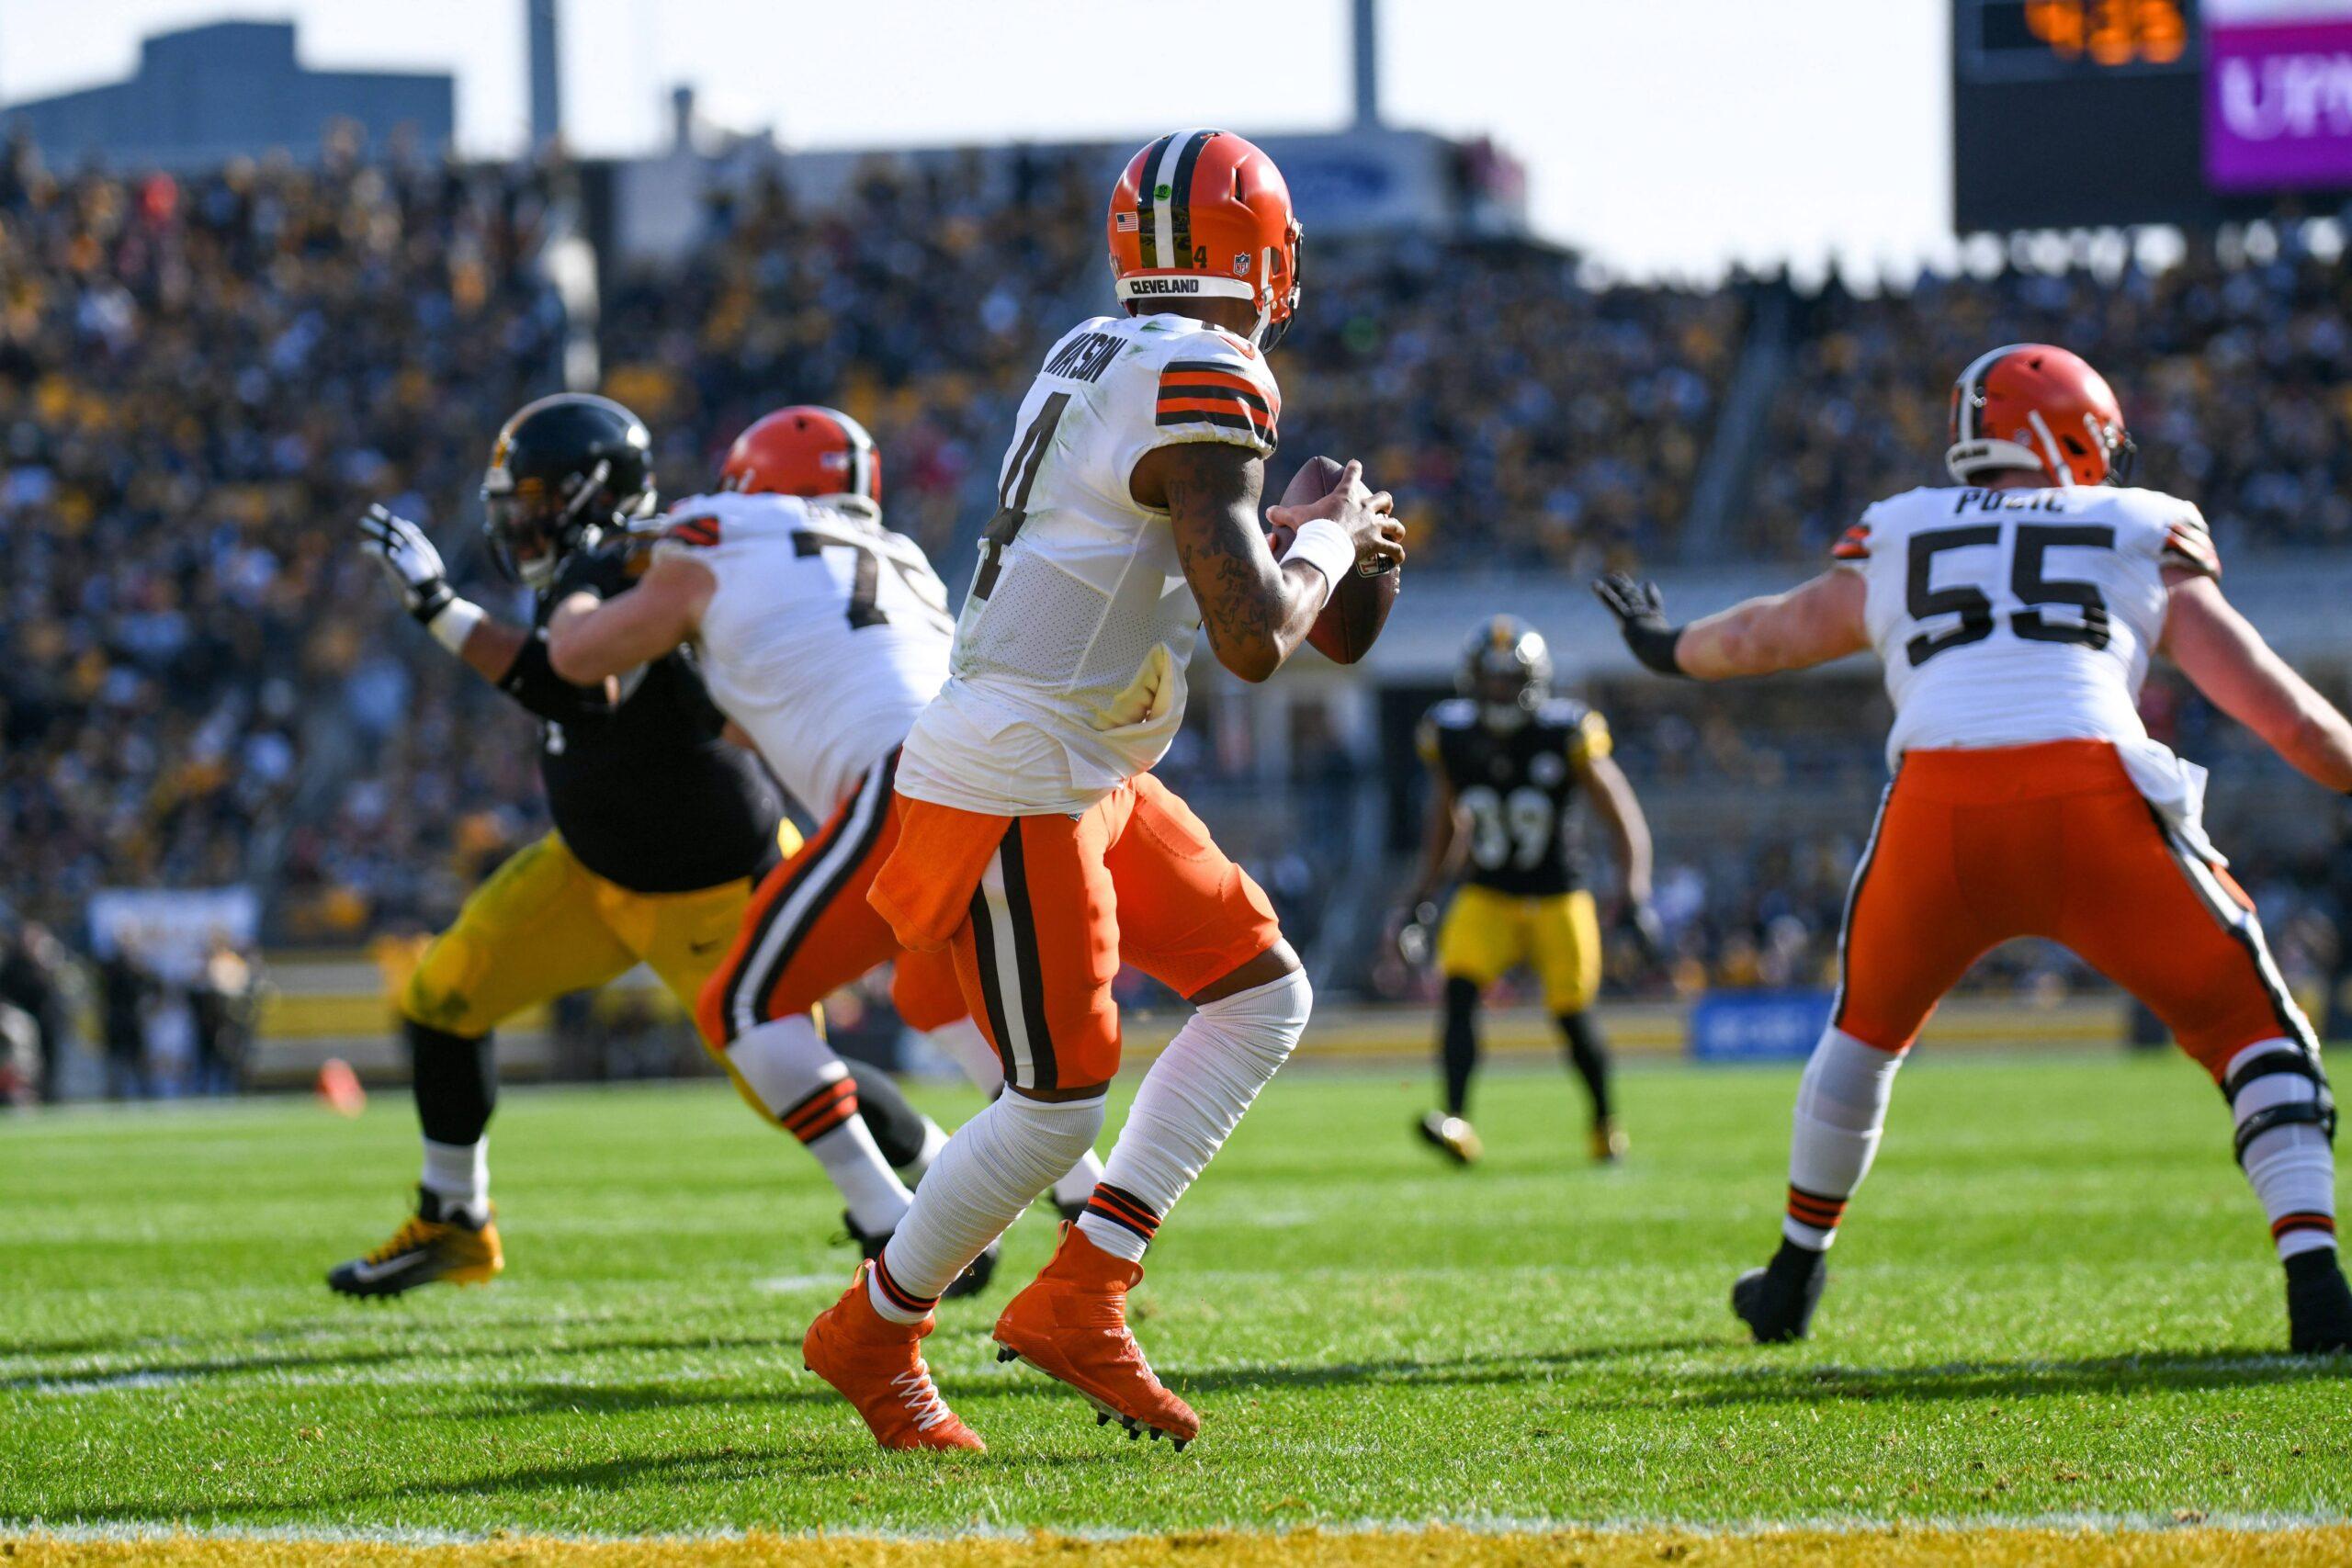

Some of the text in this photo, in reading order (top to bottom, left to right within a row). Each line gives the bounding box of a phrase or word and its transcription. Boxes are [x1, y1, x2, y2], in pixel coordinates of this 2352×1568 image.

[1130, 279, 1199, 295] CLEVELAND
[1193, 245, 1207, 269] 4
[972, 390, 1071, 602] 4
[1906, 522, 2117, 667] 55
